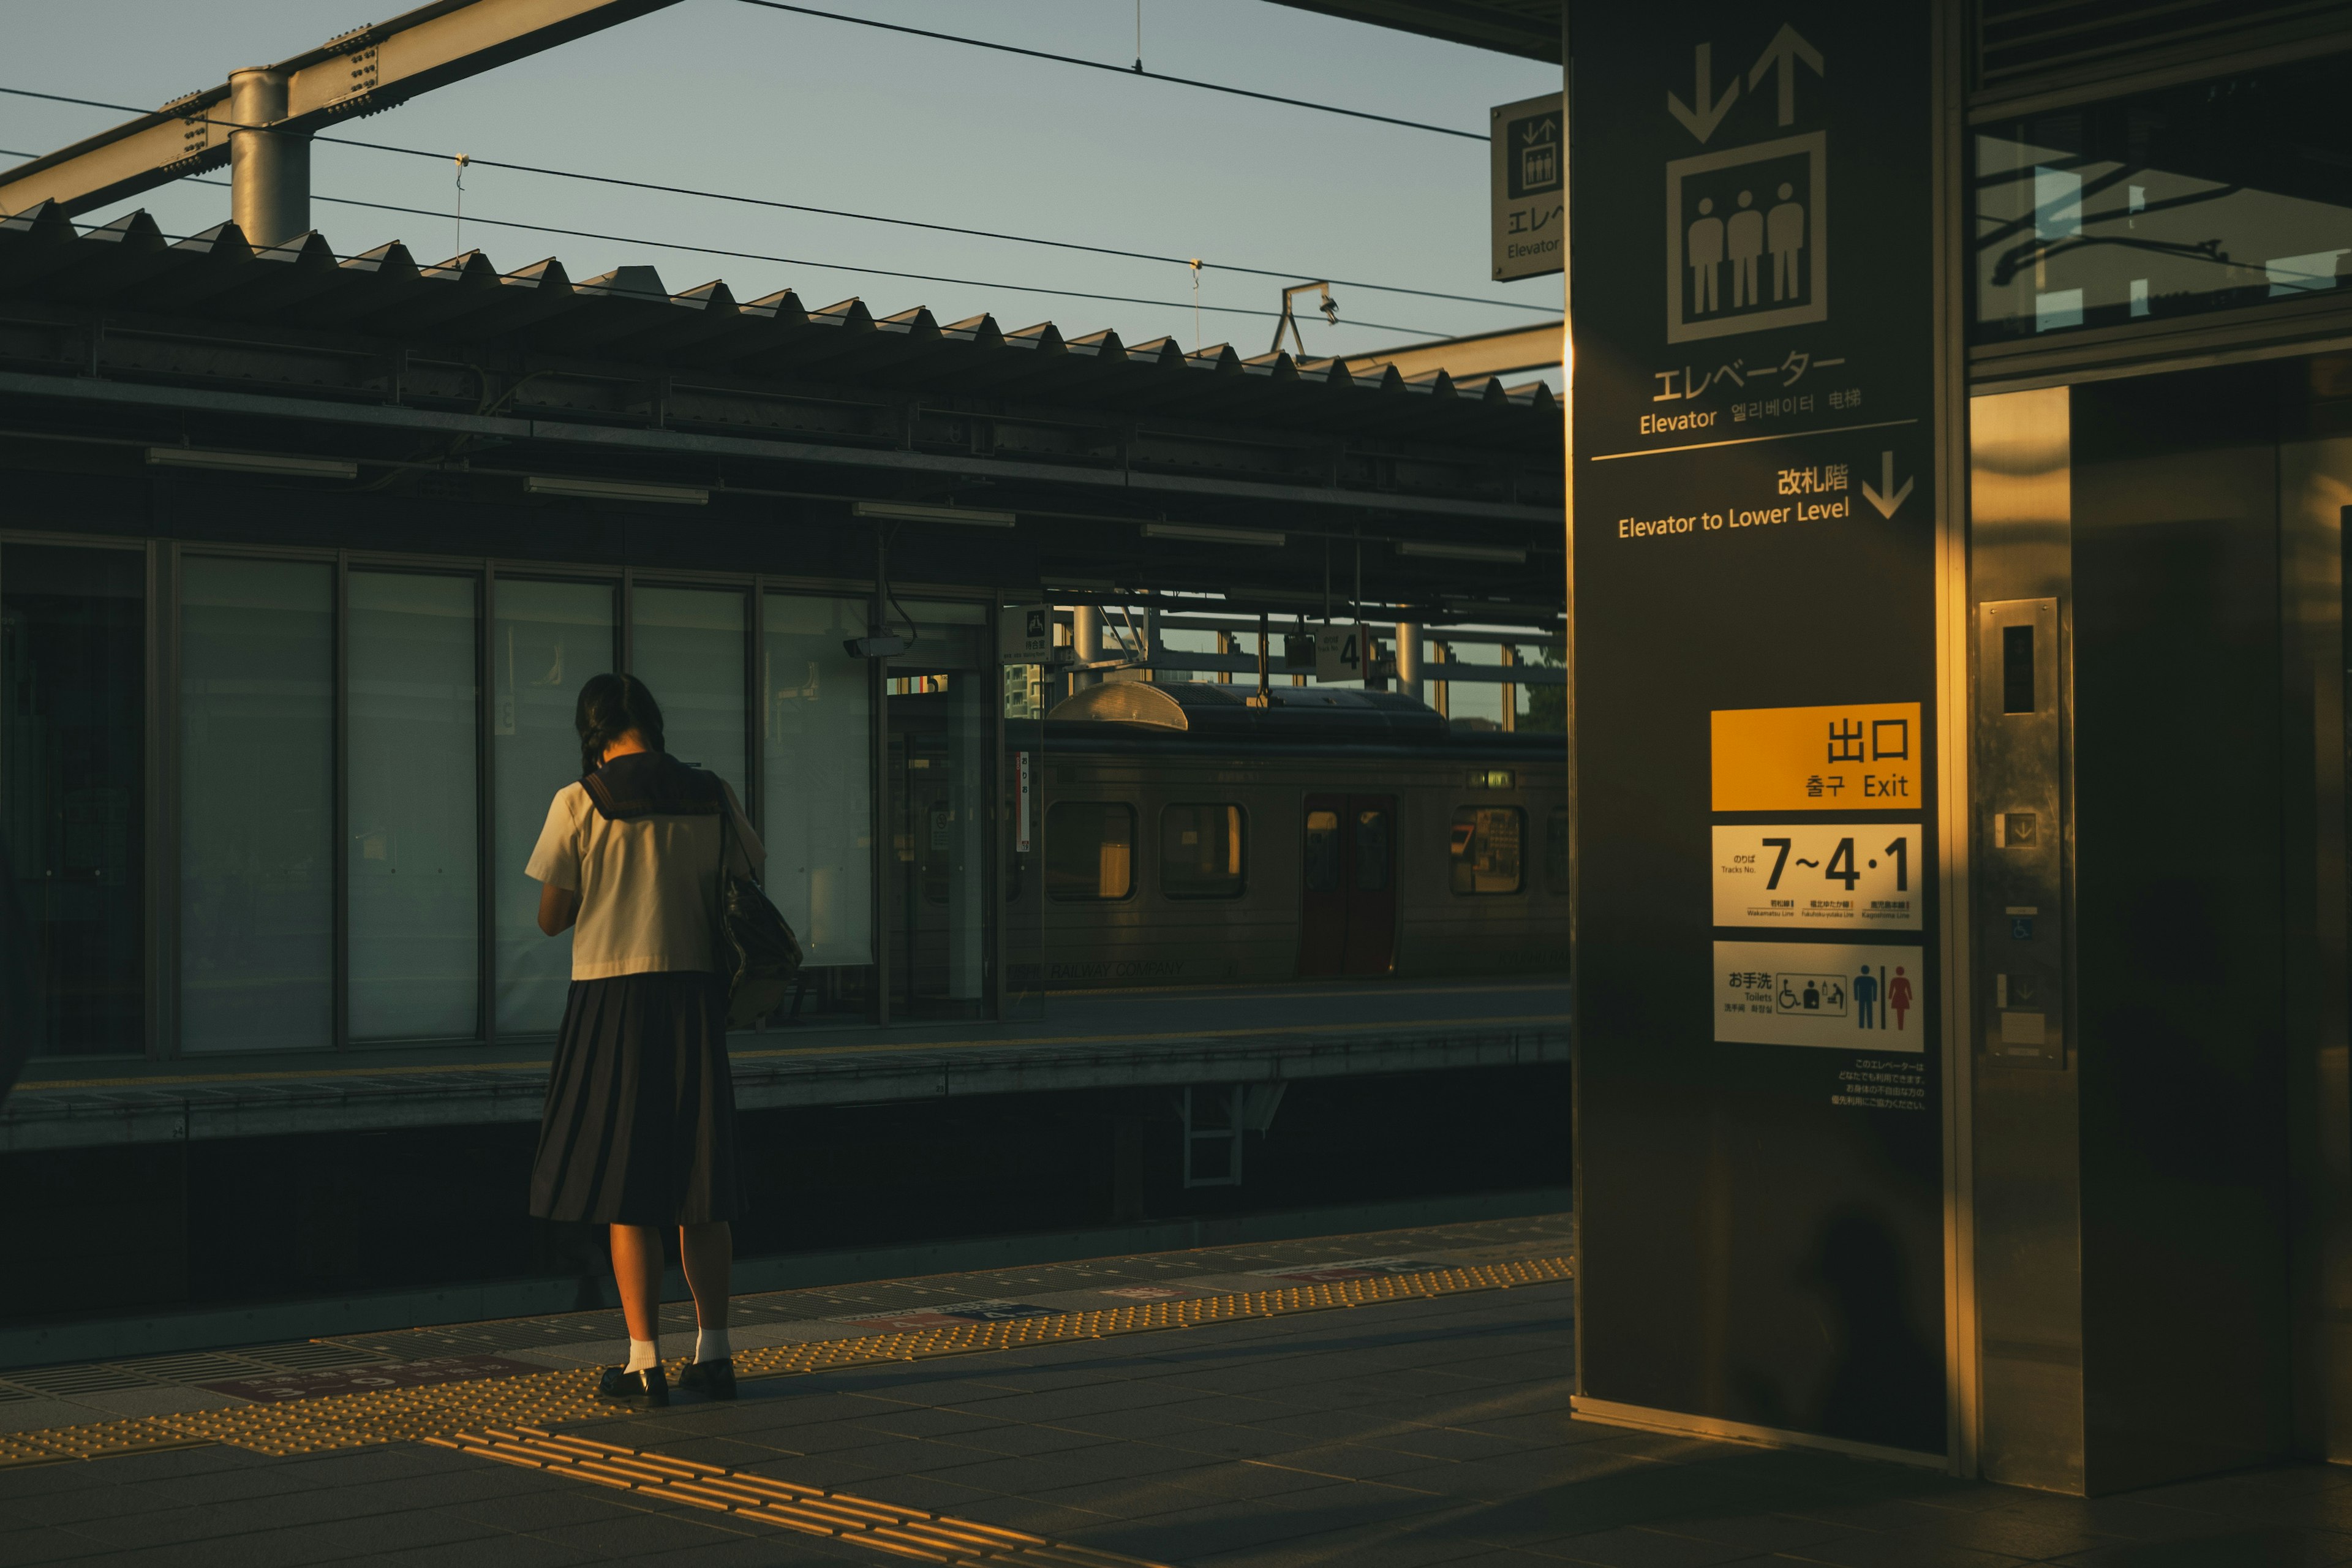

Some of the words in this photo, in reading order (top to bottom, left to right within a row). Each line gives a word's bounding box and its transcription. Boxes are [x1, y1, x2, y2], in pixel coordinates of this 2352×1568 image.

[1508, 239, 1560, 258] Elevator
[1653, 350, 1846, 402] エレベーター
[1640, 409, 1717, 435] Elevator
[1731, 394, 1814, 423] 엘리베이터
[1829, 388, 1861, 410] 电梯
[1778, 464, 1849, 495] 改札階
[1618, 514, 1697, 538] Elevator
[1702, 512, 1722, 530] to
[1729, 506, 1791, 528] Lower
[1797, 497, 1849, 519] Level
[1340, 633, 1360, 670] 4
[1828, 718, 1909, 764] 出口
[1805, 774, 1845, 797] 출구
[1864, 774, 1909, 797] Exit
[1733, 854, 1756, 864] のりば
[1050, 962, 1112, 979] RAILWAY
[1115, 961, 1185, 977] COMPANY
[1729, 972, 1772, 989] お手洗
[1744, 992, 1773, 1002] Toilets
